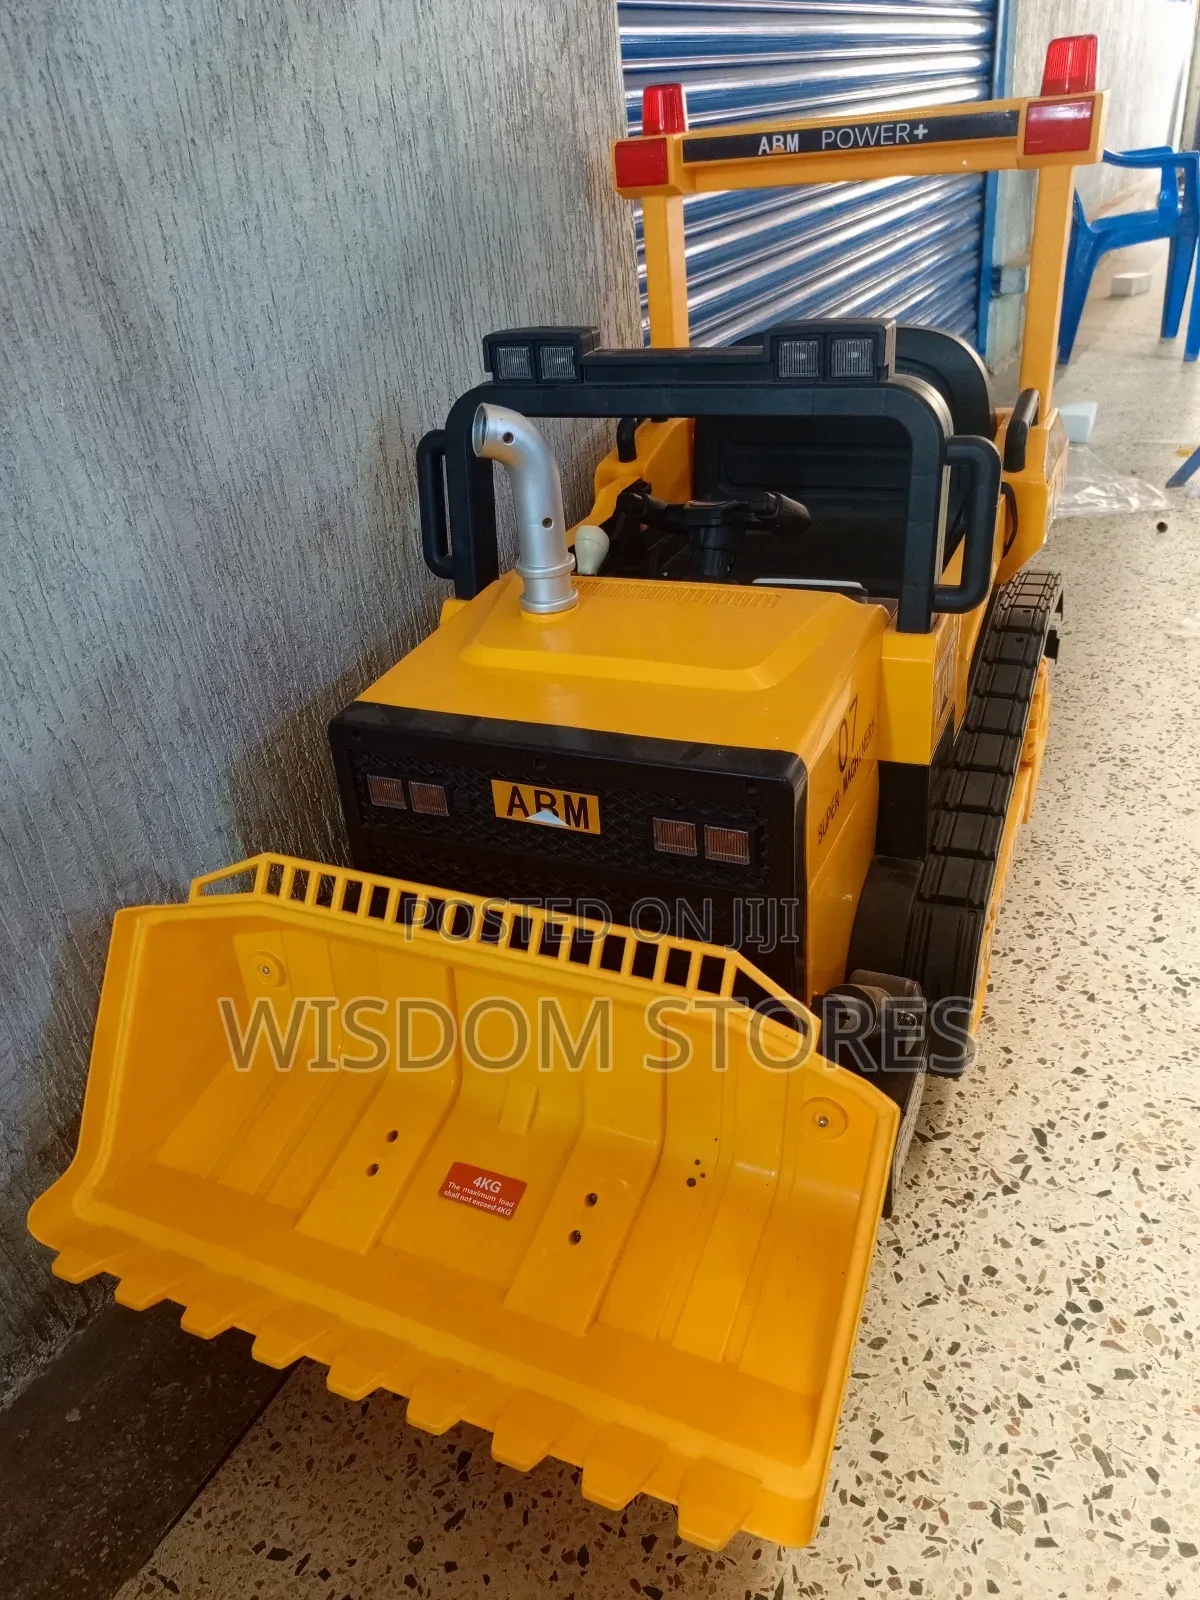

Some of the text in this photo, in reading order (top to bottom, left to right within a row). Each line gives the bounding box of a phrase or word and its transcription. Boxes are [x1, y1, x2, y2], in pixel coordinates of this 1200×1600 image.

[821, 124, 929, 150] POWER+
[838, 693, 858, 772] 07
[506, 785, 589, 830] ABM
[817, 790, 840, 845] SUPER
[448, 1181, 514, 1208] The maximum load
[473, 1176, 502, 1193] 4KG
[443, 1190, 512, 1216] shall not exceed 4KG
